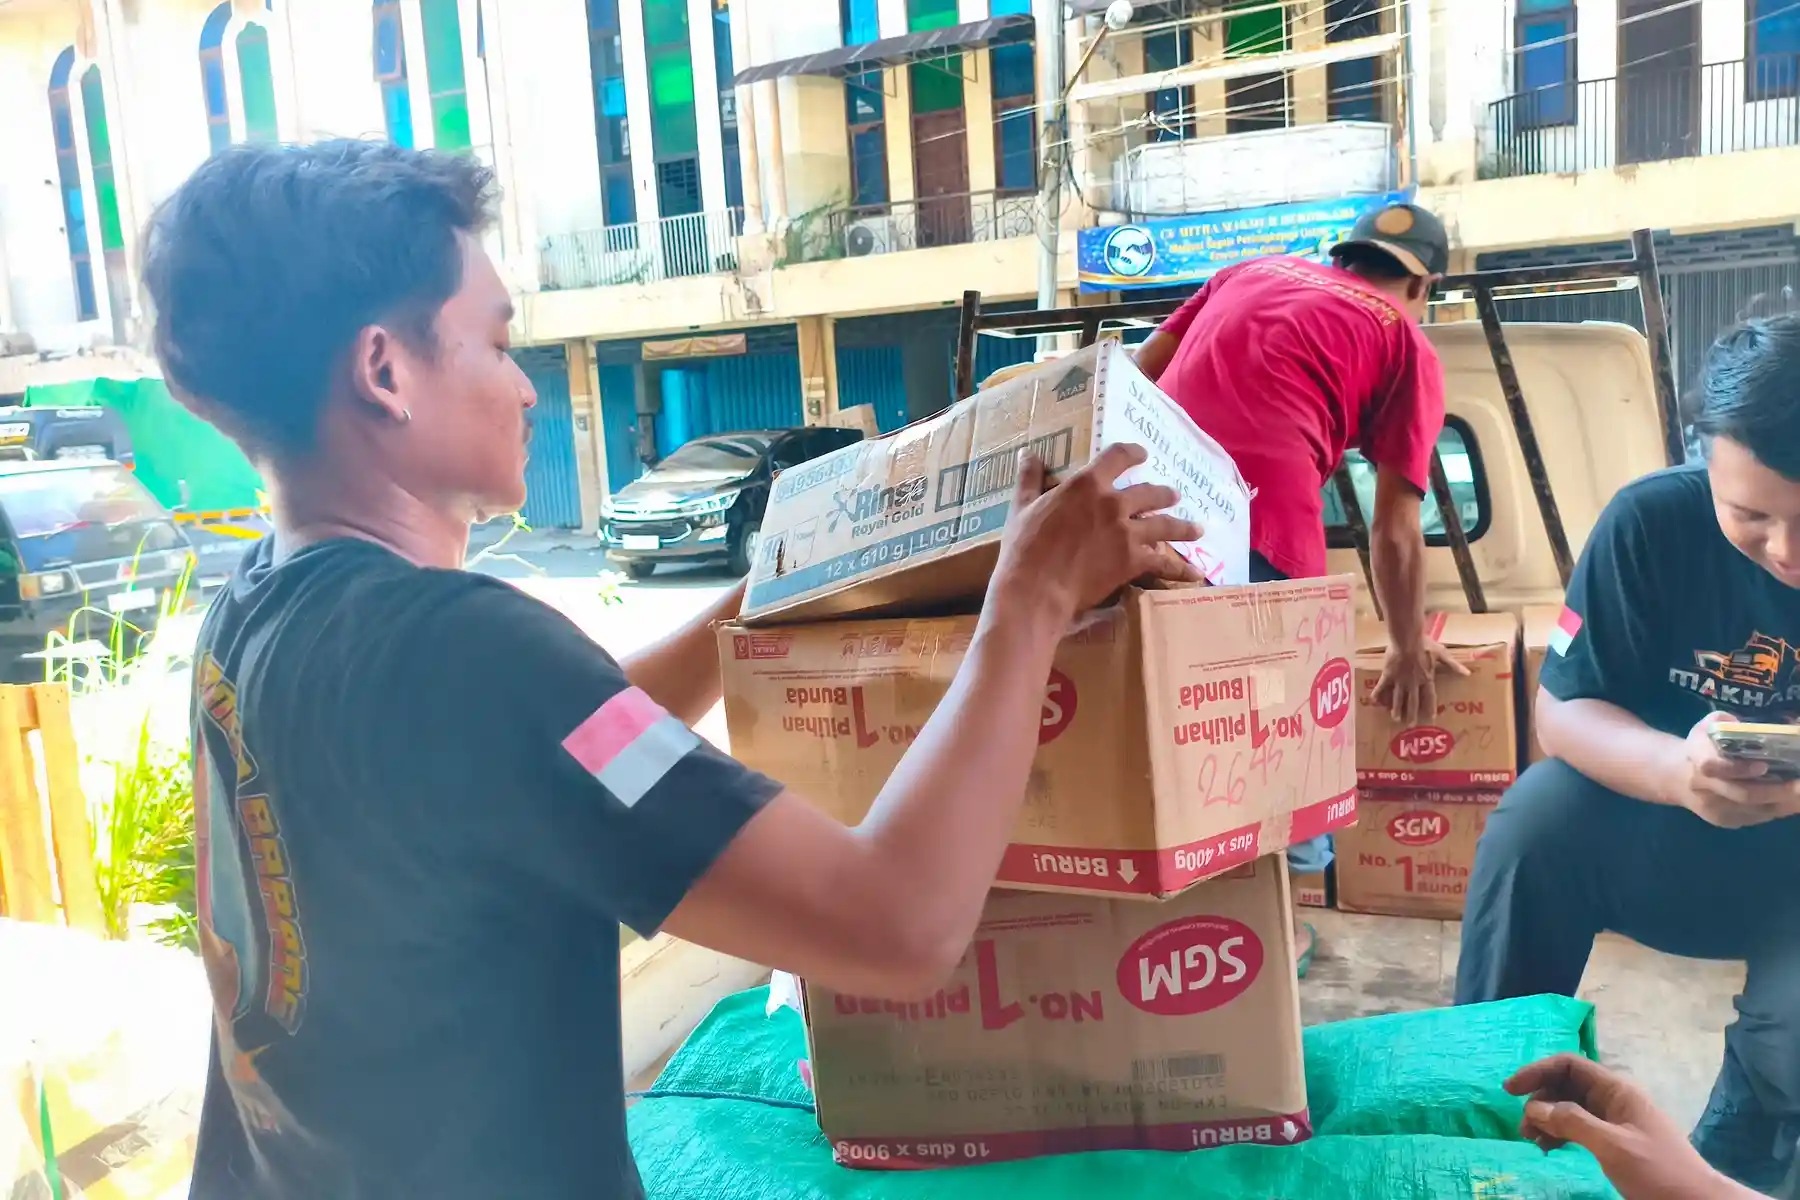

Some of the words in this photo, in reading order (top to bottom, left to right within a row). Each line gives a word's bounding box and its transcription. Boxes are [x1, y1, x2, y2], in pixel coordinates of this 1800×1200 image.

[1059, 382, 1086, 400] ATAS
[891, 502, 925, 524] Gold
[825, 562, 843, 579] 12
[918, 515, 982, 549] LIQUID
[1316, 670, 1351, 721] SGM
[782, 716, 851, 739] Pilihan
[851, 686, 880, 748] 1
[1173, 713, 1246, 747] Pilihan
[1399, 733, 1448, 758] SGM
[1393, 816, 1442, 838] SGM
[1229, 832, 1253, 852] dus
[1033, 853, 1110, 878] BARU!
[1174, 848, 1214, 872] 400g
[1395, 855, 1414, 892] 1
[1415, 861, 1469, 877] Piliha
[1416, 880, 1467, 895] Bund
[1137, 934, 1249, 1003] SGM
[974, 939, 1026, 1031] 1
[1191, 1123, 1272, 1148] BARU!
[836, 1140, 891, 1163] 900g
[917, 1141, 956, 1158] dus
[964, 1141, 990, 1159] 10
